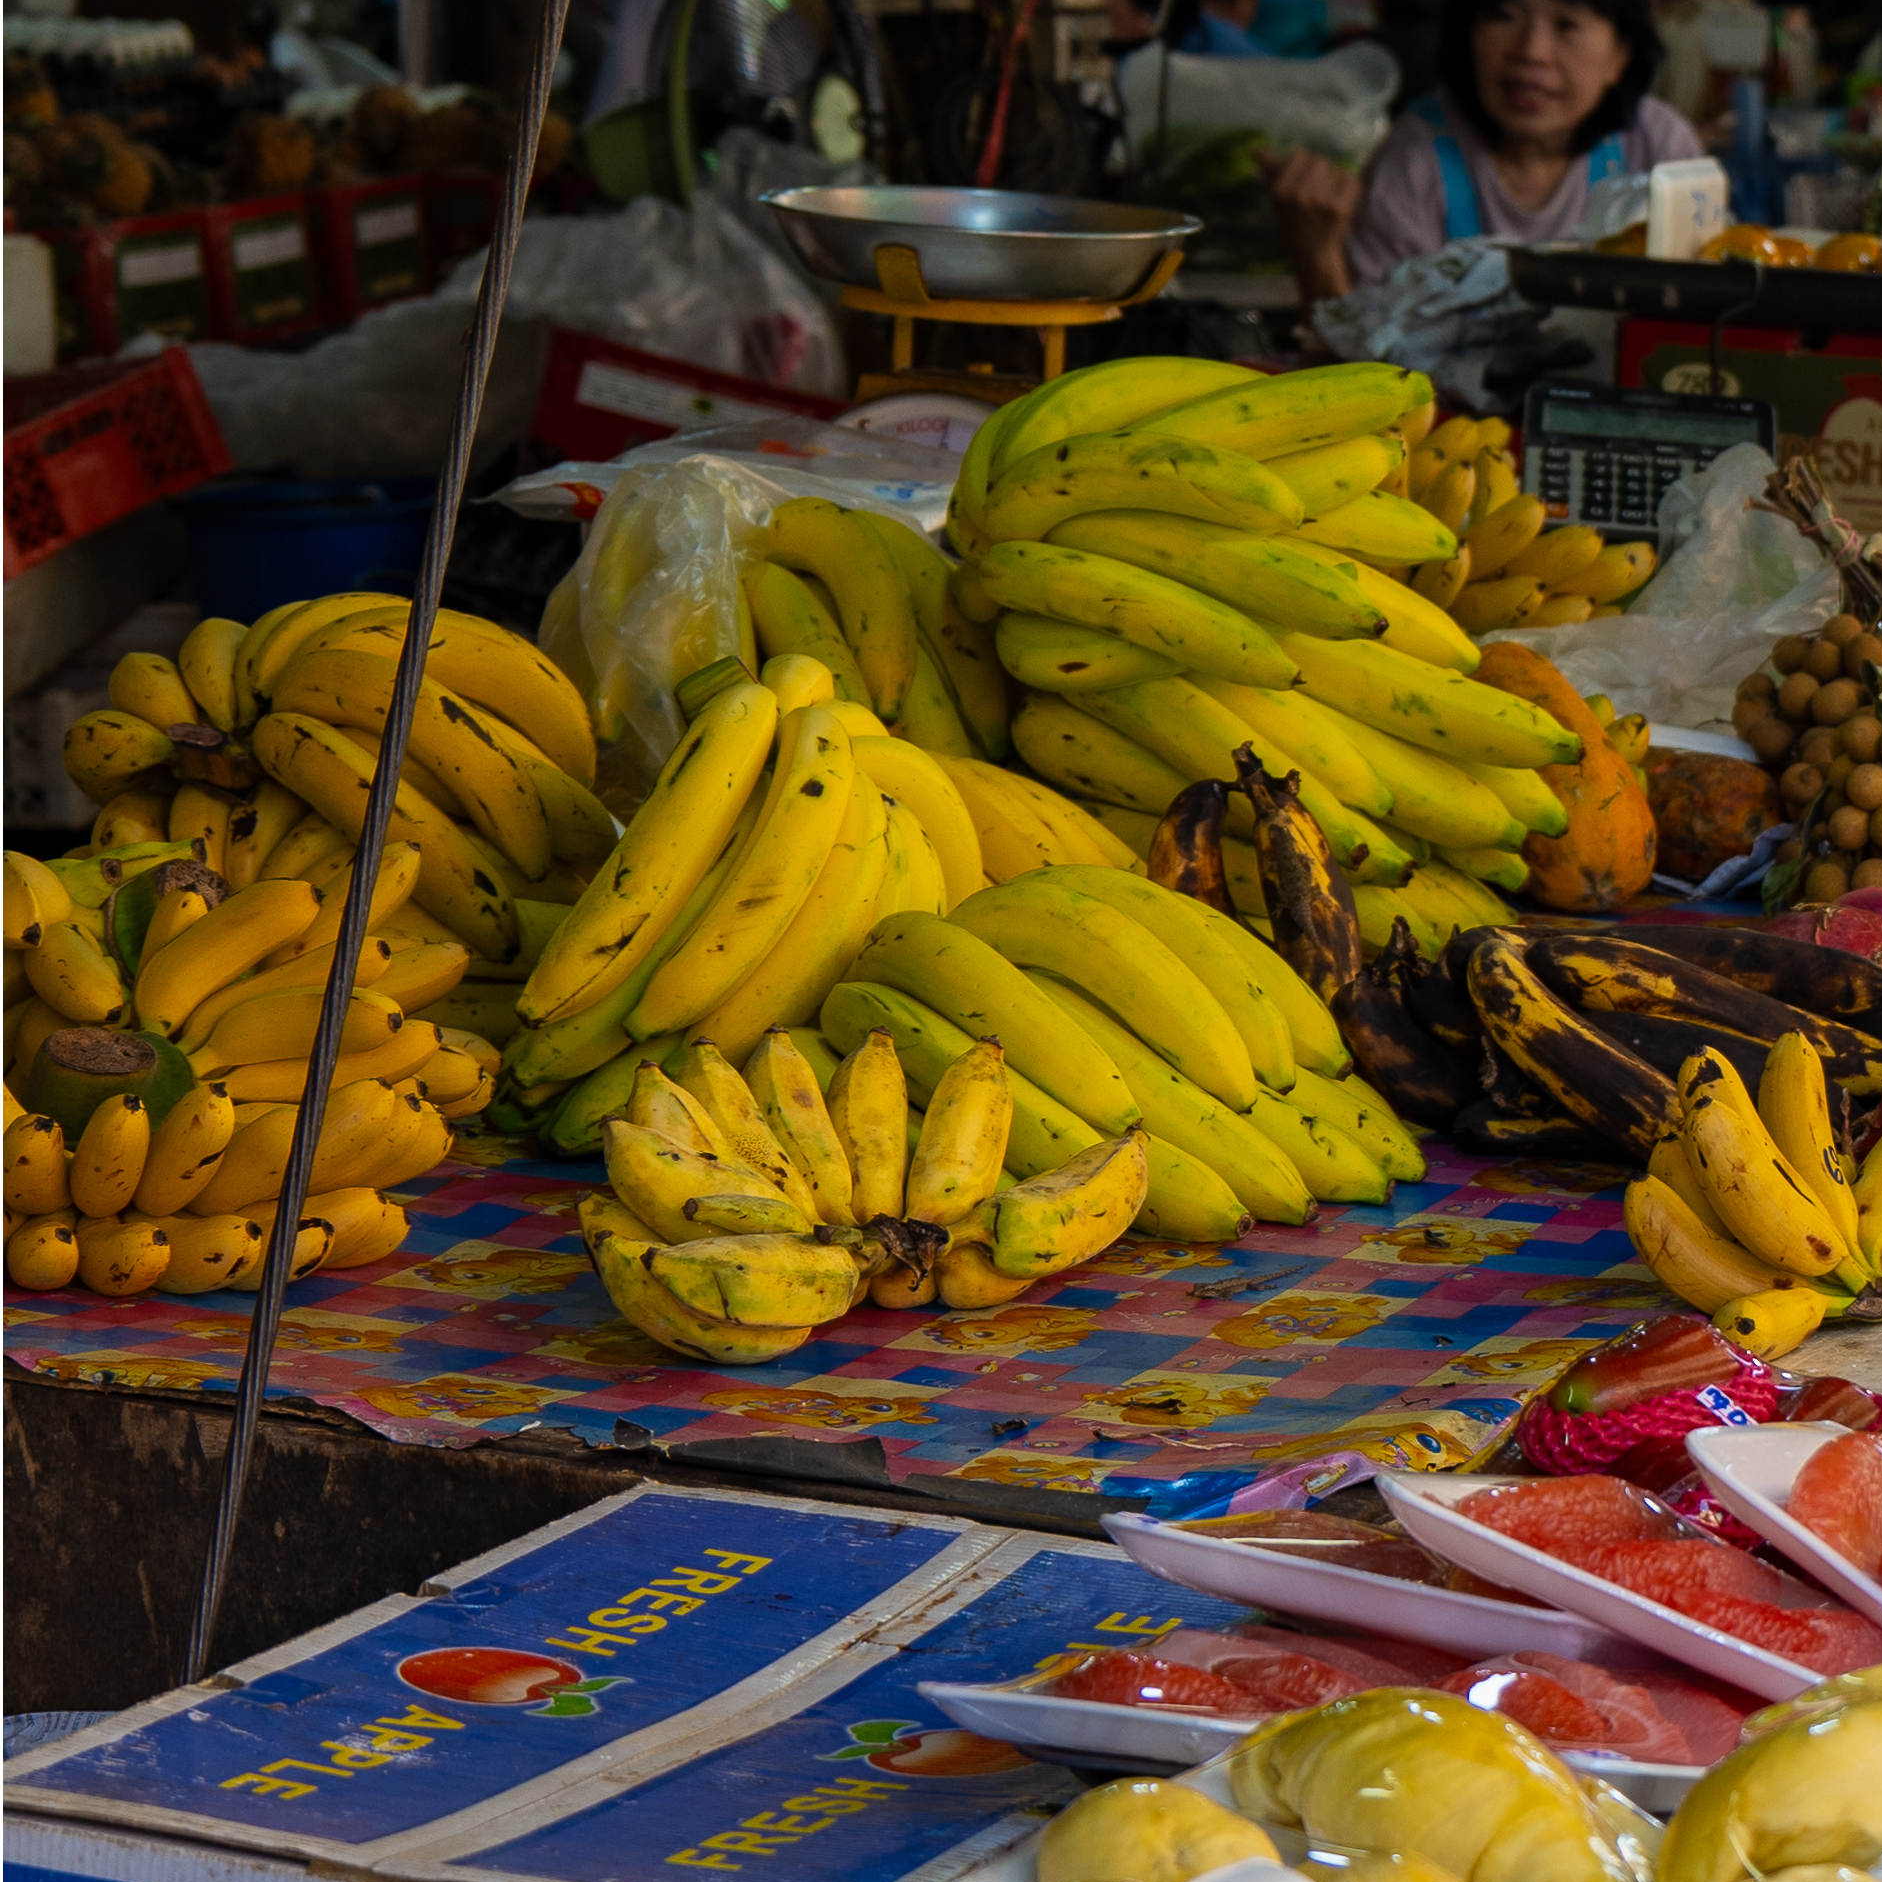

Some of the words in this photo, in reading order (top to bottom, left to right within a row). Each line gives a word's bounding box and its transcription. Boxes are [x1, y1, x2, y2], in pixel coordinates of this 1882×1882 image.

[544, 1547, 773, 1656] FRESH
[218, 1704, 467, 1801] APPLE
[664, 1777, 910, 1872] FRESH
